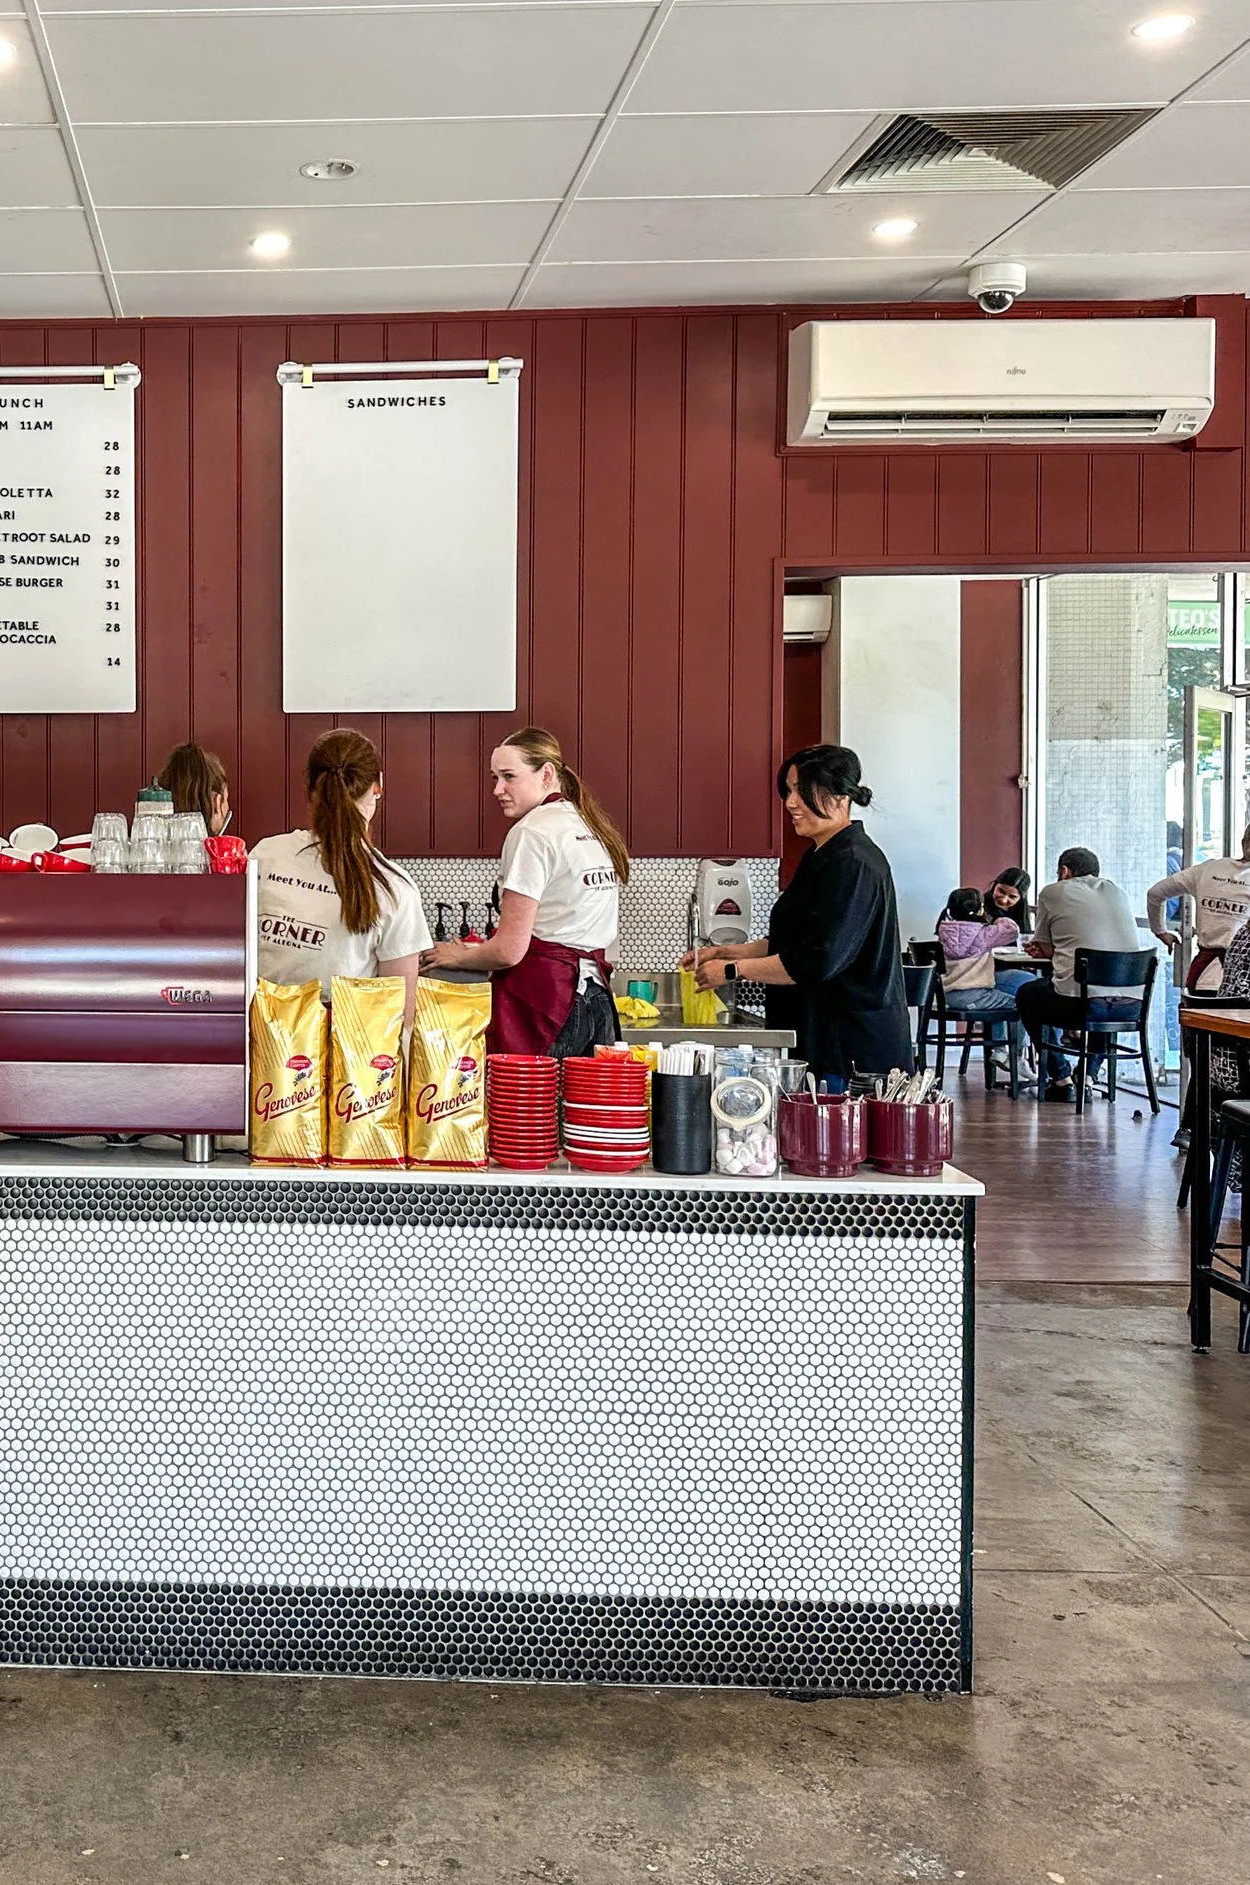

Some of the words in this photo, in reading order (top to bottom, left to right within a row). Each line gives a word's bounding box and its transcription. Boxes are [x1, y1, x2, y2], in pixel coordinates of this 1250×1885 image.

[347, 396, 446, 409] SANDWICHES
[20, 420, 53, 431] 11AM
[104, 441, 120, 451] 28
[105, 465, 121, 476] 28
[105, 489, 120, 499] 32
[105, 511, 121, 521] 28
[49, 533, 91, 544] SALAD
[104, 535, 120, 545] 29
[10, 554, 80, 566] SANDWICH
[105, 557, 120, 568] 30
[15, 577, 63, 588] BURGER
[106, 579, 120, 589] 31
[106, 601, 120, 611] 31
[105, 622, 121, 633] 28
[1167, 625, 1217, 637] elicatessen
[107, 657, 121, 667] 14
[268, 873, 294, 886] Meet
[296, 879, 315, 890] You
[583, 871, 618, 886] CORN
[1202, 898, 1247, 914] CORNER
[259, 919, 326, 947] ORNER
[273, 938, 301, 950] ALTONA
[254, 1082, 317, 1122] Genovese
[415, 1083, 480, 1125] Genovese
